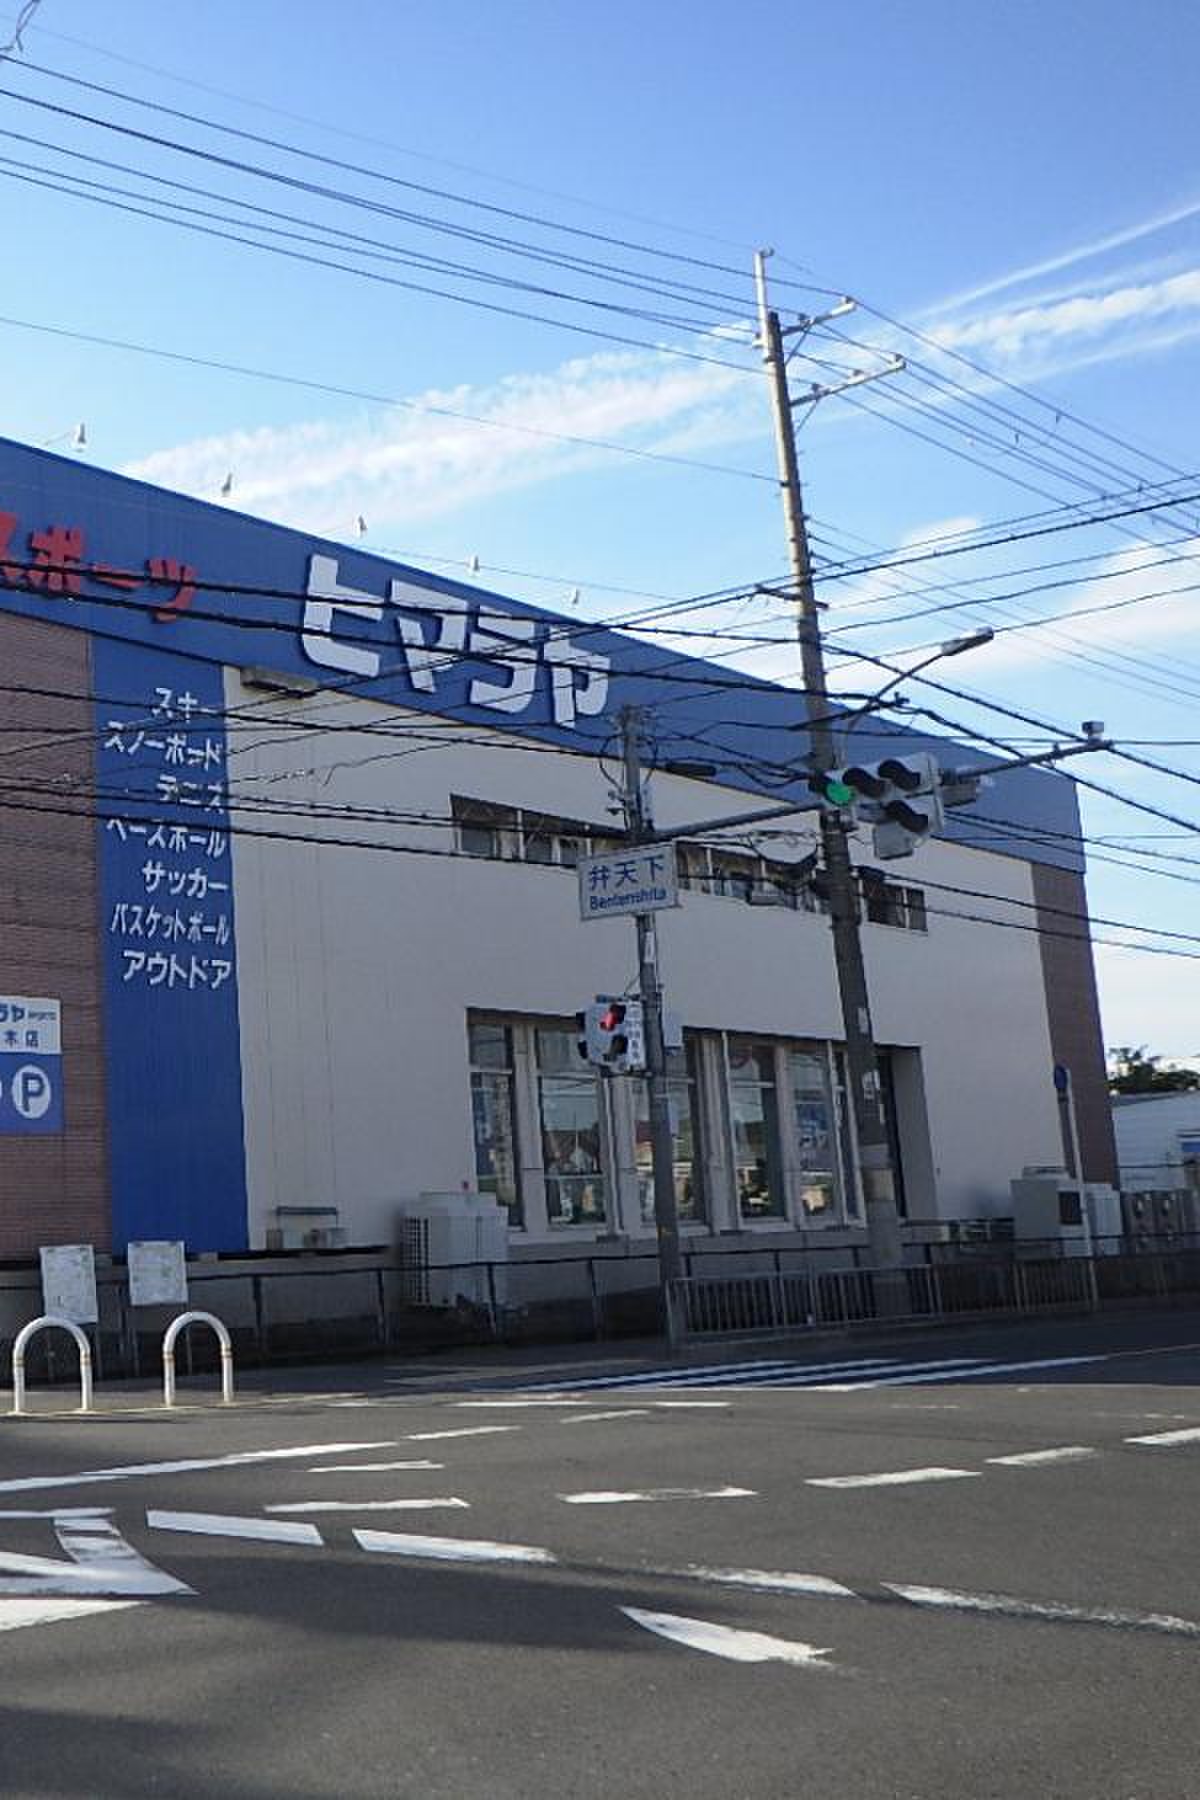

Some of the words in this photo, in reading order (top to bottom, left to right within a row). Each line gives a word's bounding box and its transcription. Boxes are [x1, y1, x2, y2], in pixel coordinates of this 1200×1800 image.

[301, 553, 611, 728] ヒマラヤ
[104, 721, 223, 772] スノーボード
[142, 860, 228, 898] サッカー
[110, 903, 230, 946] バスケットボール
[123, 950, 231, 989] アウトドア
[21, 1071, 45, 1113] P
